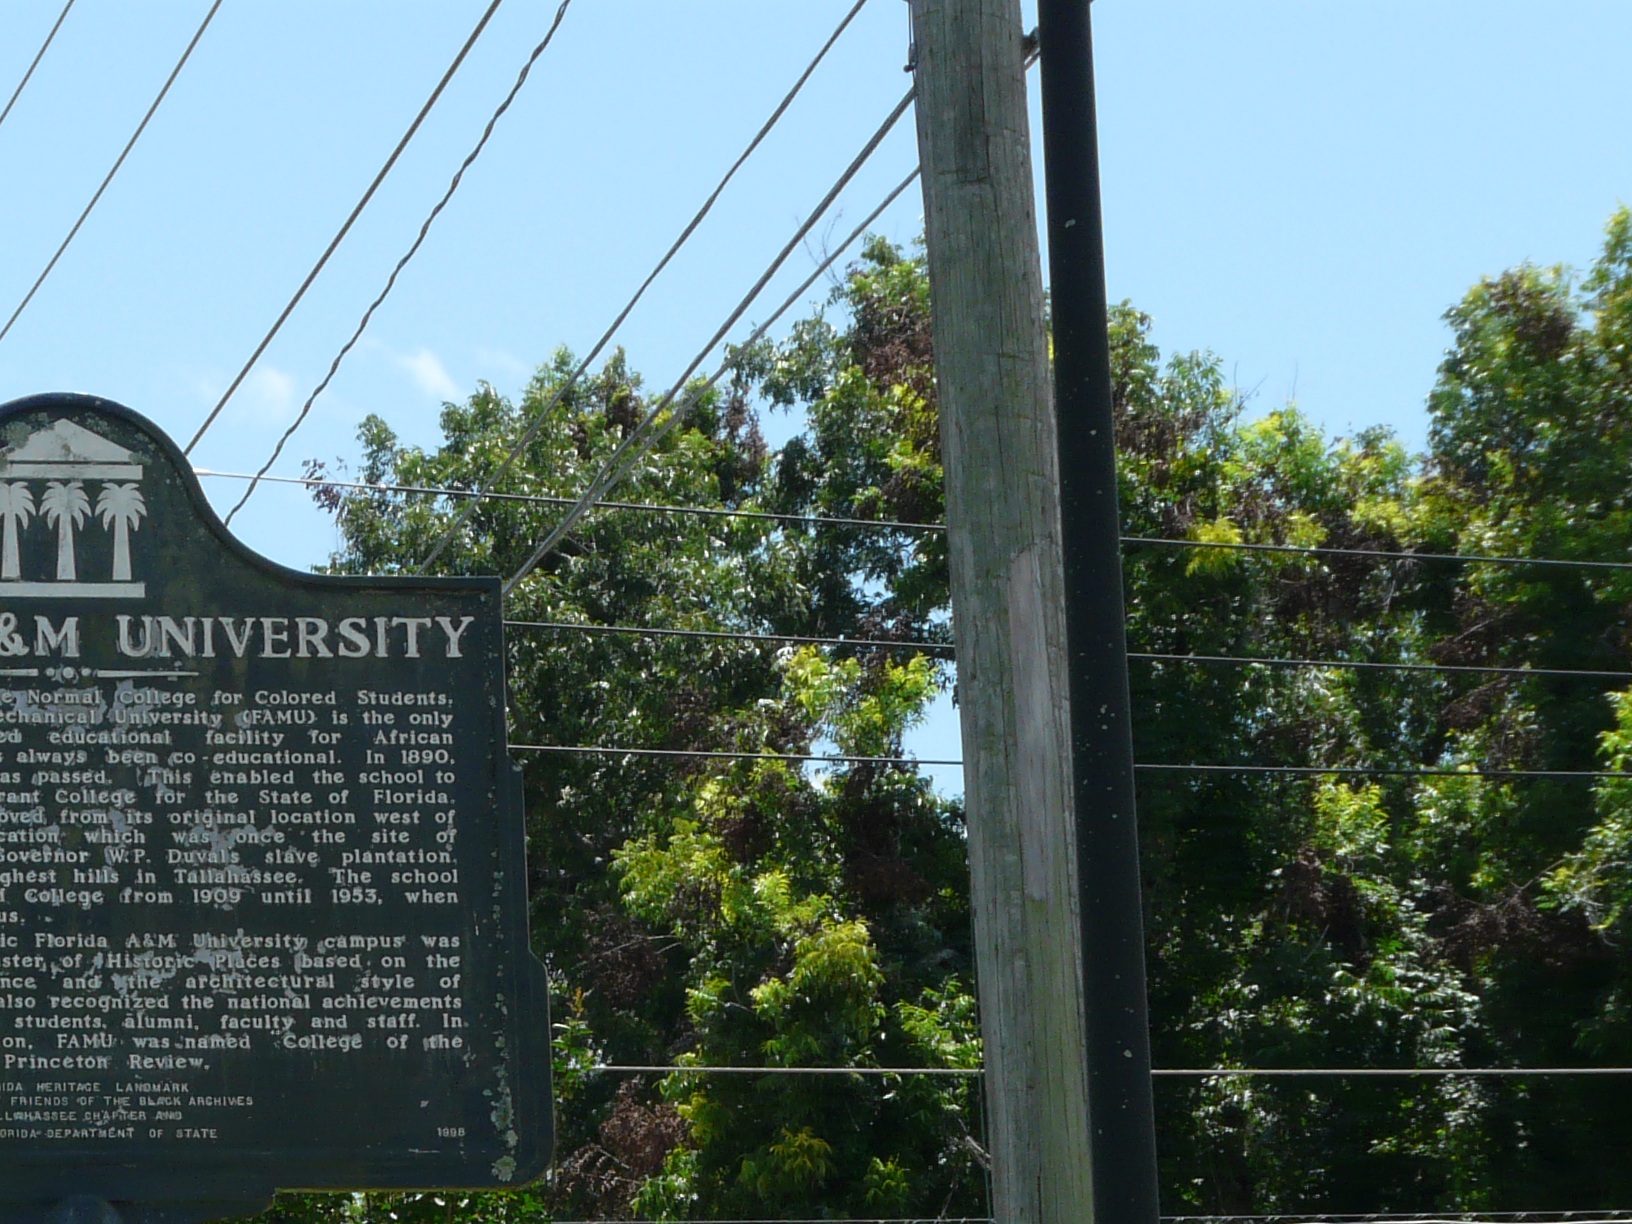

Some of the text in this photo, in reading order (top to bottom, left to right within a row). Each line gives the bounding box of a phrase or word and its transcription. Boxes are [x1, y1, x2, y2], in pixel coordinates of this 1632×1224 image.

[118, 614, 474, 659] UNIVERSITY
[114, 710, 222, 729] University
[333, 710, 348, 725] is
[363, 710, 394, 725] the
[410, 710, 453, 729] only
[49, 727, 171, 743] educational
[206, 729, 283, 749] facility
[311, 729, 341, 745] for
[374, 729, 453, 745] African
[37, 768, 113, 788] passed.
[148, 769, 191, 785] This
[210, 769, 294, 785] enabled
[313, 769, 344, 785] the
[359, 769, 423, 785] school
[435, 769, 455, 785] to
[55, 787, 136, 808] College
[156, 790, 185, 805] for
[205, 790, 238, 805] the
[259, 790, 312, 805] State
[330, 790, 348, 805] of
[84, 828, 145, 844] which
[172, 832, 210, 844] was
[235, 832, 284, 844] once
[312, 828, 345, 844] the
[372, 828, 409, 844] site
[436, 828, 455, 844] of
[63, 975, 101, 990] and
[128, 975, 160, 990] the
[185, 975, 334, 990] architectural
[360, 975, 415, 994] style
[440, 975, 459, 990] of
[51, 994, 168, 1014] recognized
[181, 994, 214, 1010] the
[227, 994, 309, 1010] national
[322, 994, 462, 1010] achievements
[4, 1053, 108, 1069] Princeton
[129, 1055, 210, 1070] Review.
